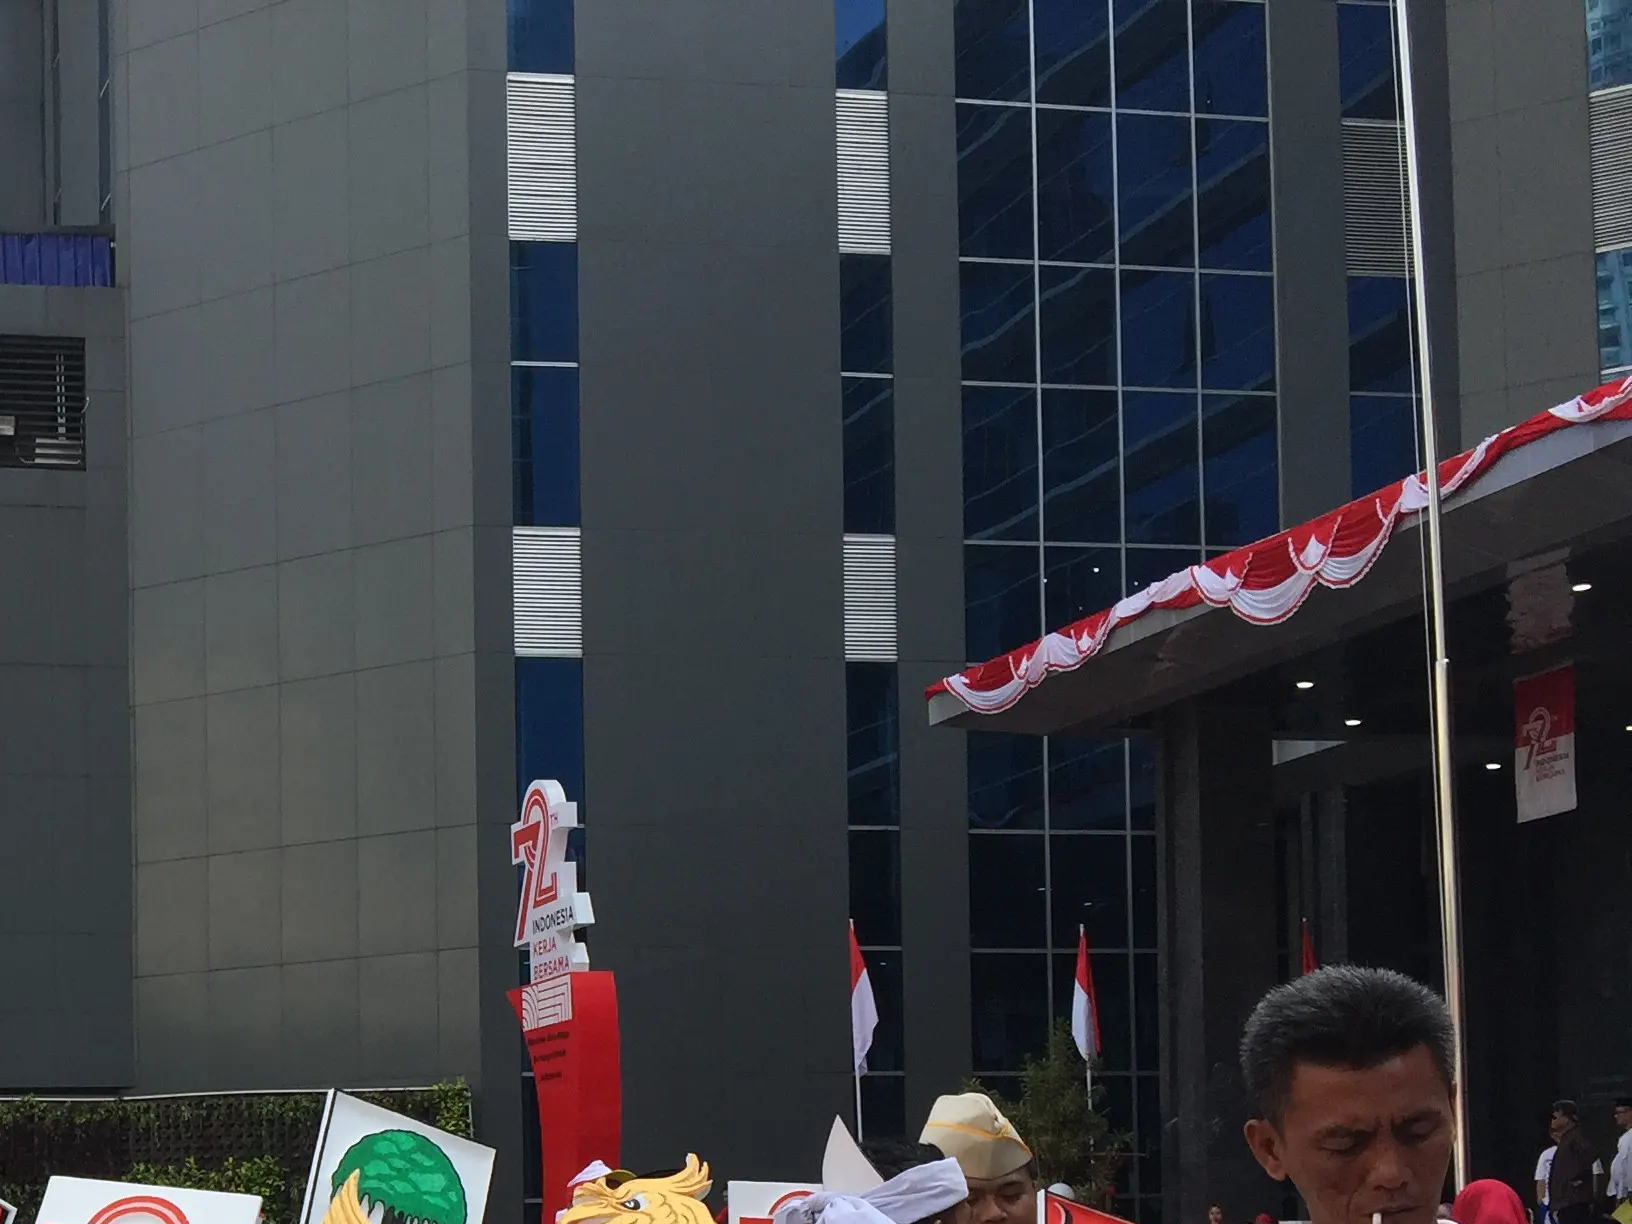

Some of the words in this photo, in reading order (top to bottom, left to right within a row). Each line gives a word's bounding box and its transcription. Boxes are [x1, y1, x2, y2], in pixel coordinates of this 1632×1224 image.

[532, 906, 574, 936] INDONESIA
[532, 936, 557, 958] KERJA
[532, 955, 570, 981] BERSAMA
